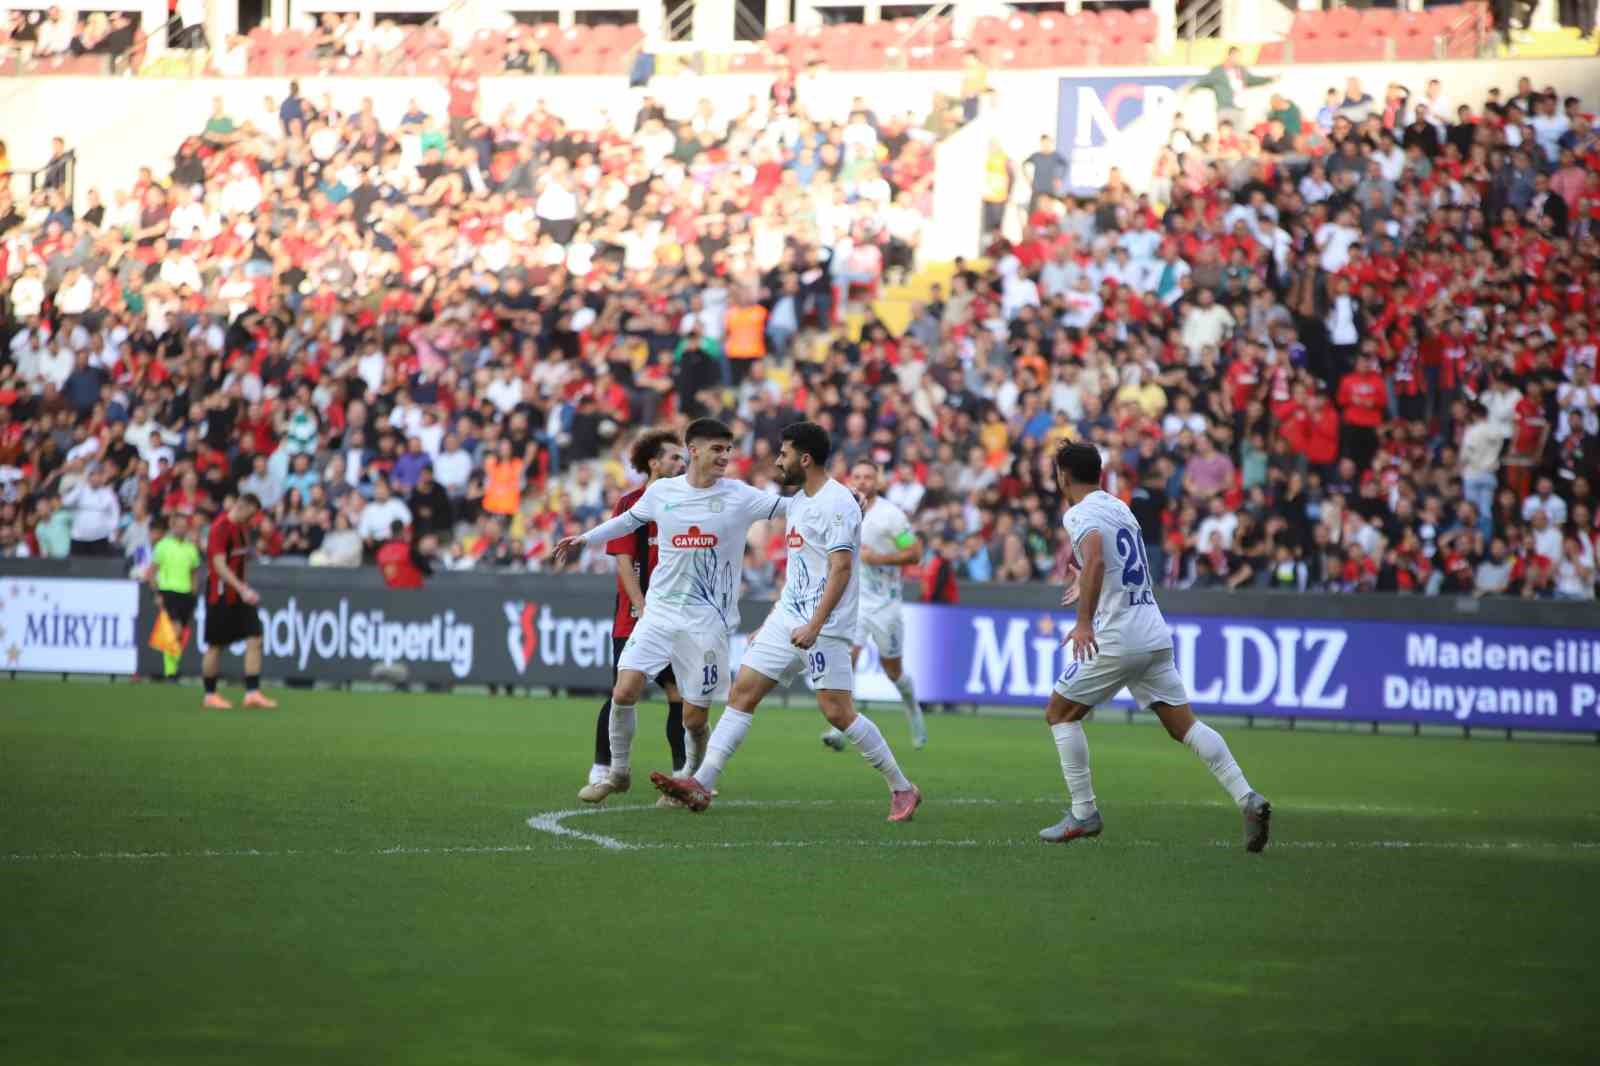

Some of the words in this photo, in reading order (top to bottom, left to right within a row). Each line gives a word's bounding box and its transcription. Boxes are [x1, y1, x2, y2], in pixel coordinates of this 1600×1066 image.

[702, 664, 718, 685] 18
[1384, 675, 1558, 719] Dünyanın
[1571, 683, 1600, 716] P
